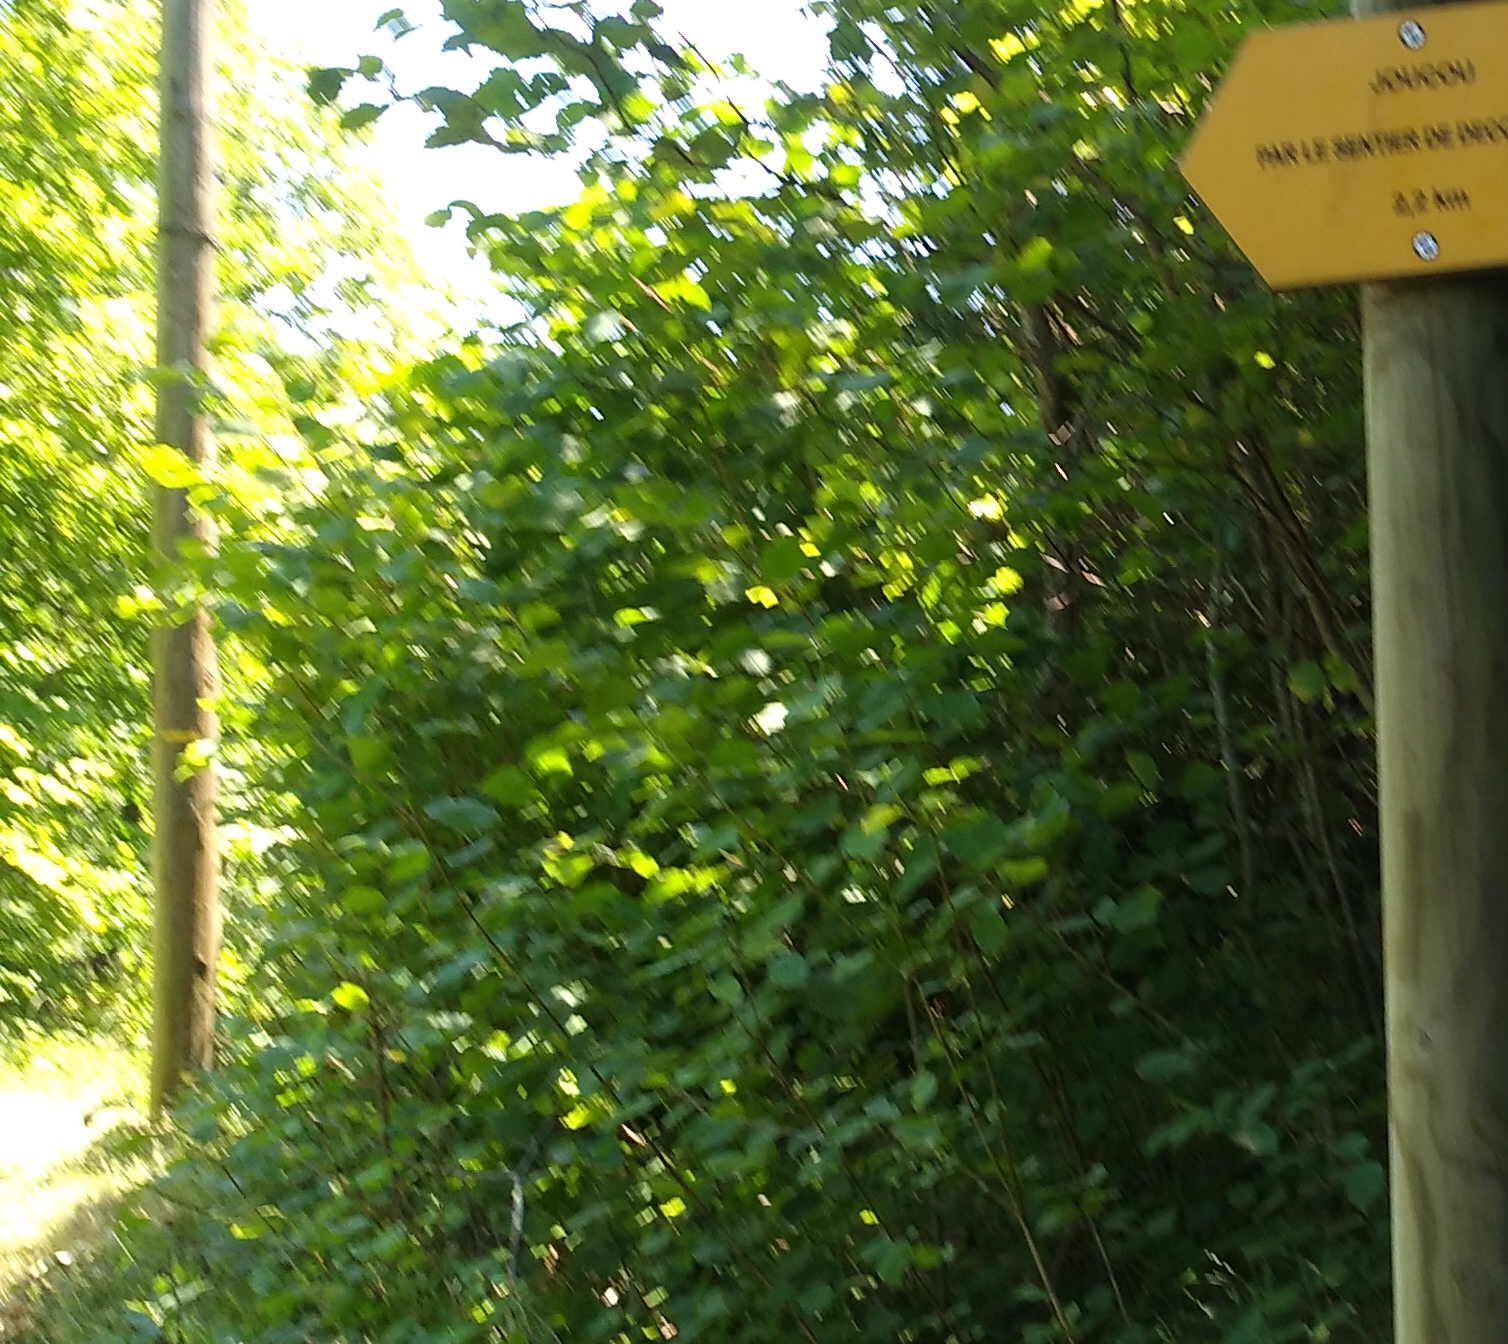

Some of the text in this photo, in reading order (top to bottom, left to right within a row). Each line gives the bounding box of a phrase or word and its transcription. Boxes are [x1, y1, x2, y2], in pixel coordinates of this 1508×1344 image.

[1369, 57, 1477, 96] JOUCOU
[1255, 139, 1301, 170] PAR
[1301, 135, 1330, 165] LE
[1331, 126, 1422, 161] SENTIER
[1423, 120, 1455, 151] DE
